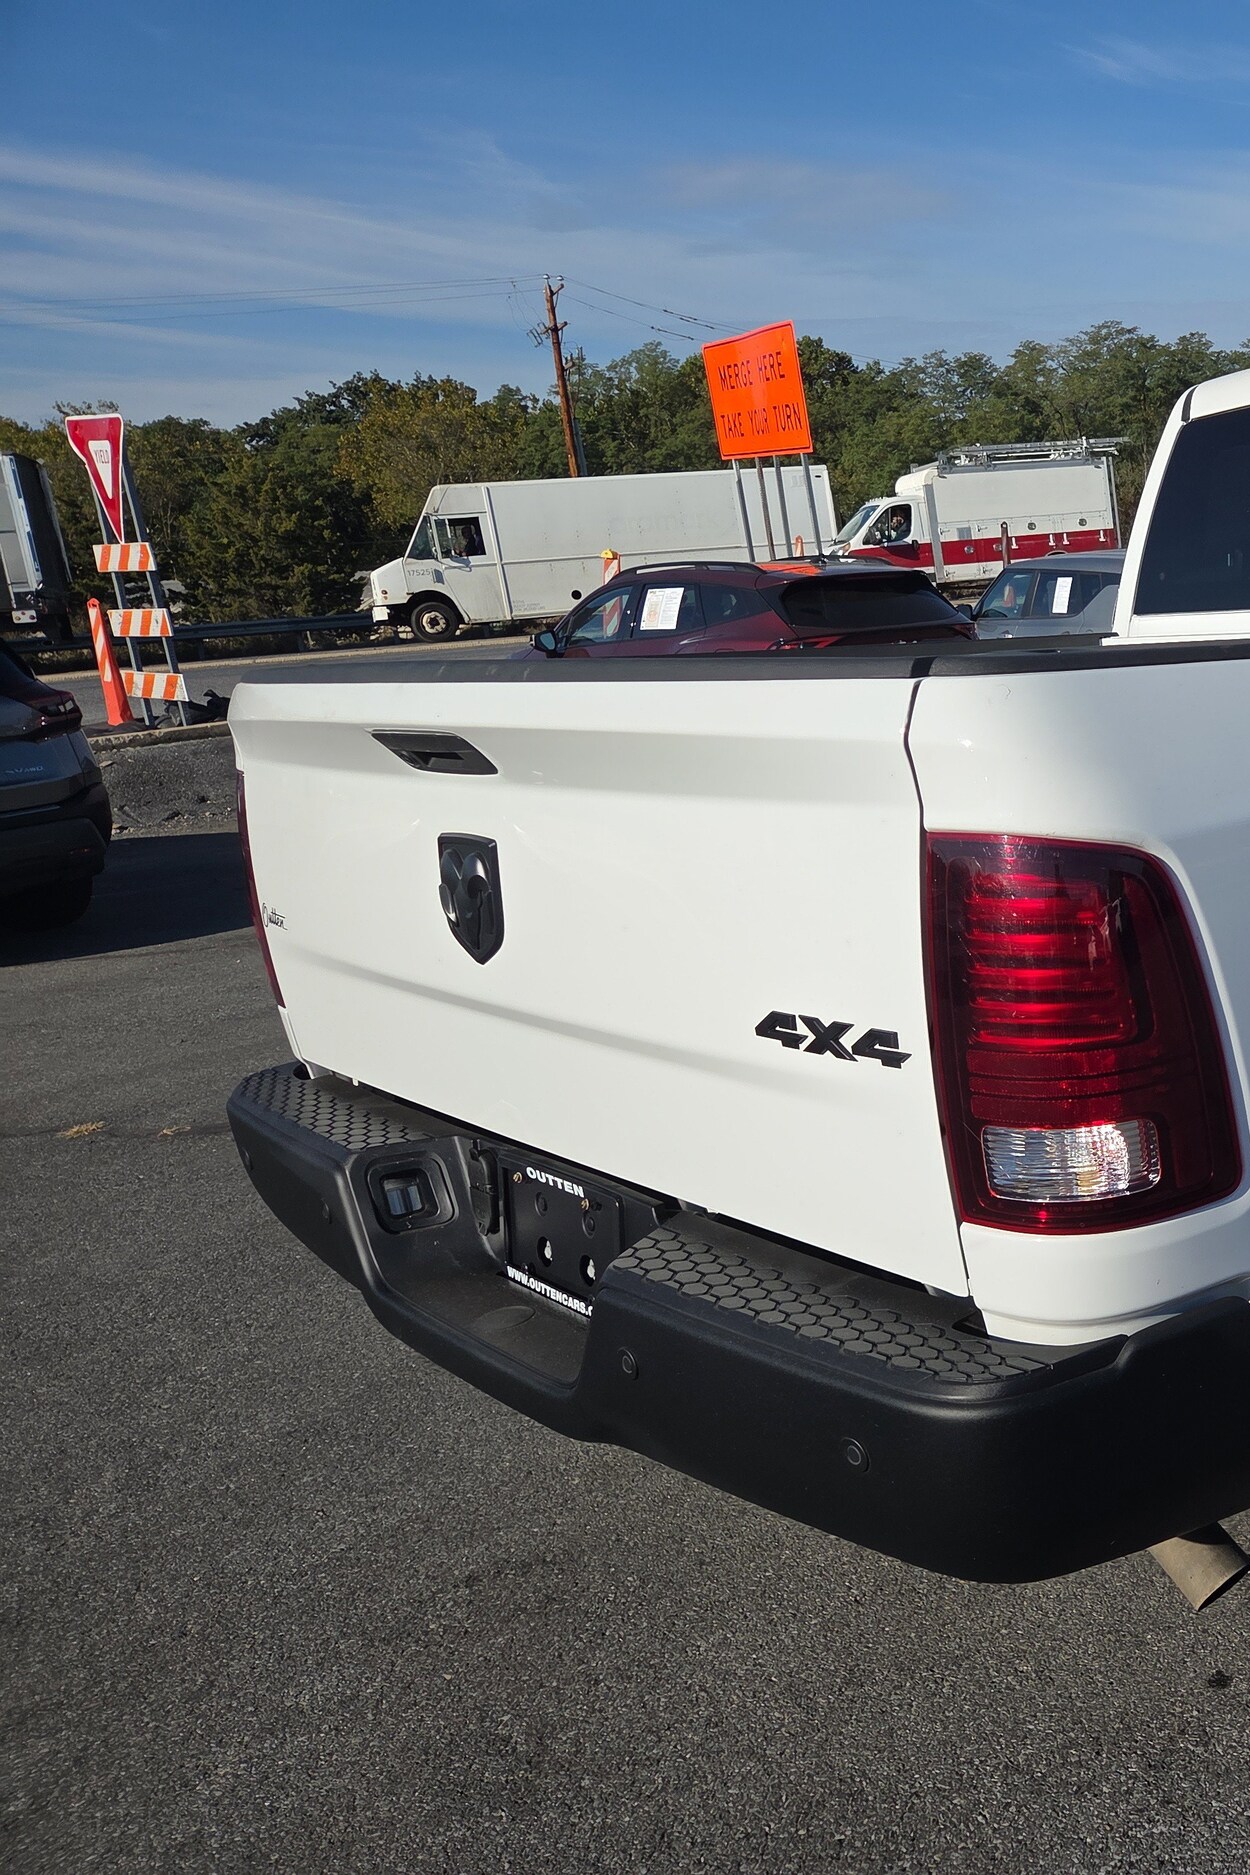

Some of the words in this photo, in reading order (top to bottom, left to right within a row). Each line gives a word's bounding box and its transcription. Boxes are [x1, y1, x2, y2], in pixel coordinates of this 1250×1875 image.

[717, 360, 754, 392] MERGE
[756, 351, 786, 383] HERE
[720, 412, 745, 439] TAKE
[748, 408, 770, 436] YOUR
[773, 402, 803, 432] TURN
[94, 449, 110, 464] YIELD
[526, 1166, 585, 1198] OUTTEN
